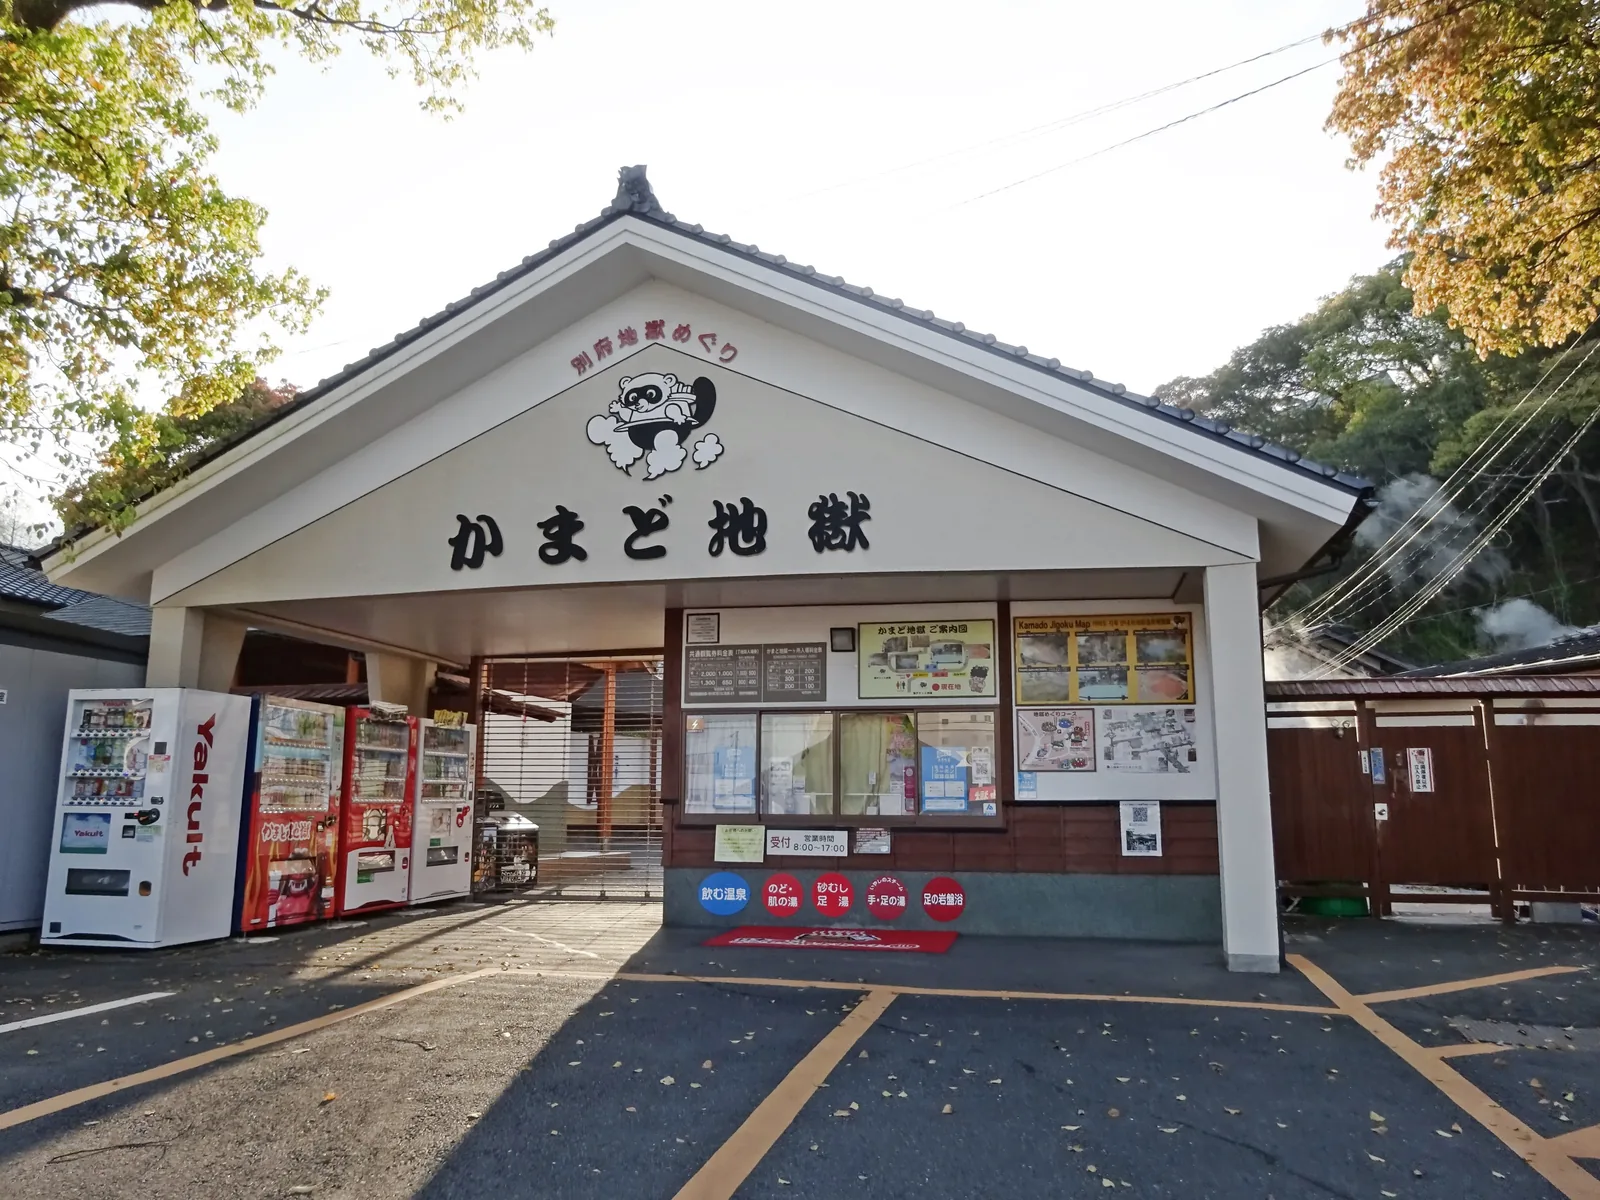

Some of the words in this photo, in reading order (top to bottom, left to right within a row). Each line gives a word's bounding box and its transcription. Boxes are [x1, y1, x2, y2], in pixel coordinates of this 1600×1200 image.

[571, 319, 738, 375] 別府地獄めぐり
[450, 491, 871, 570] かまど地獄
[878, 624, 926, 635] かまど地獄
[929, 624, 968, 634] ご案内図
[1019, 621, 1048, 630] Kamado
[1050, 621, 1074, 630] Jigoku
[1075, 620, 1091, 629] Map
[941, 683, 962, 691] 現在地
[182, 713, 216, 877] Yakult
[770, 836, 790, 849] 受付
[804, 835, 835, 843] 営業時間
[701, 886, 747, 901] 飲む温泉
[817, 882, 849, 893] 砂むし
[767, 895, 798, 908] 肌の湯
[867, 895, 906, 907] 手・足の湯
[923, 893, 963, 906] 足の岩盤浴
